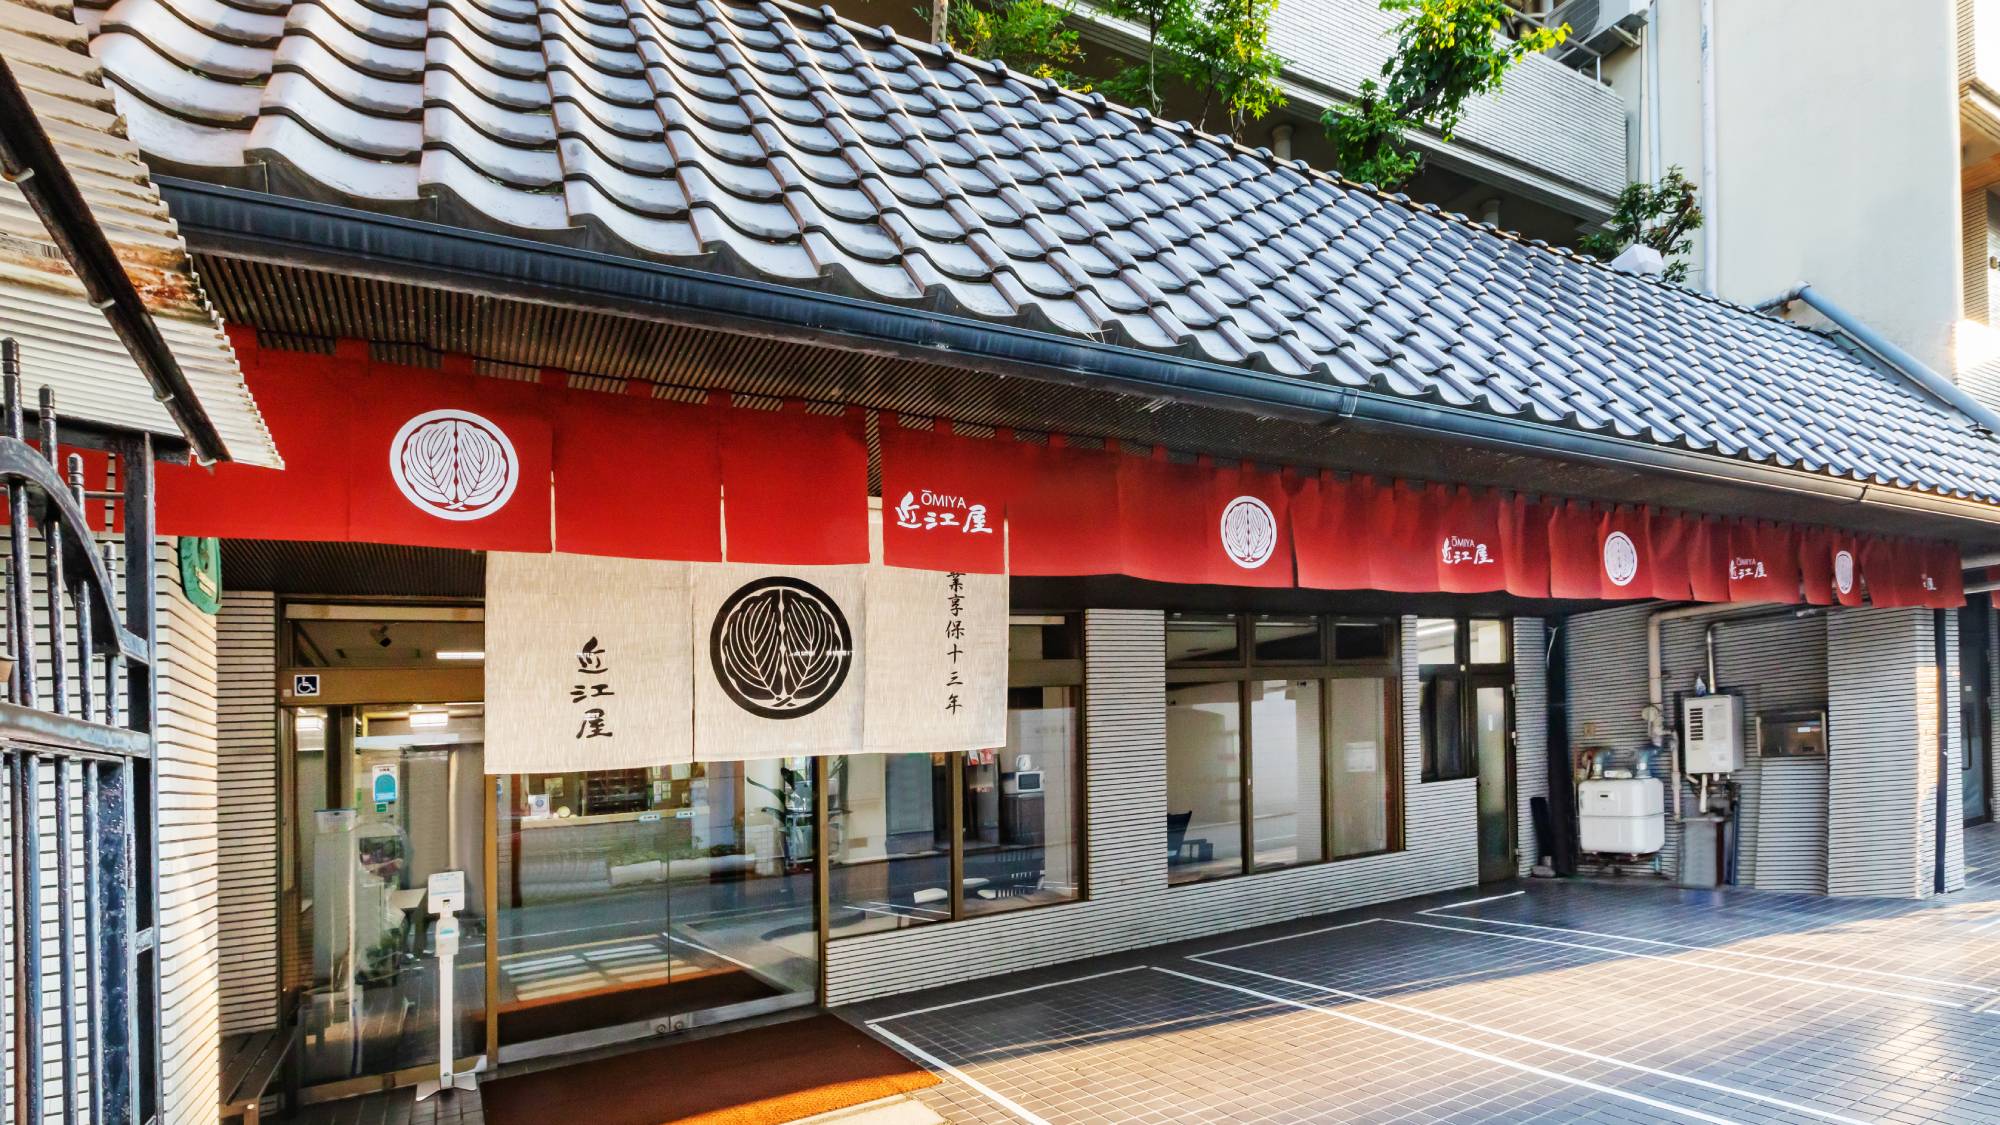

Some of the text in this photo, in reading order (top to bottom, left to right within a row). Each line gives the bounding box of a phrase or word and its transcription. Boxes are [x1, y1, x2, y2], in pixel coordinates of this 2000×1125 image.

[895, 491, 993, 533] 近江屋
[921, 489, 966, 509] ŌMIYA
[1441, 537, 1494, 565] 近江屋
[570, 636, 615, 739] 近江屋
